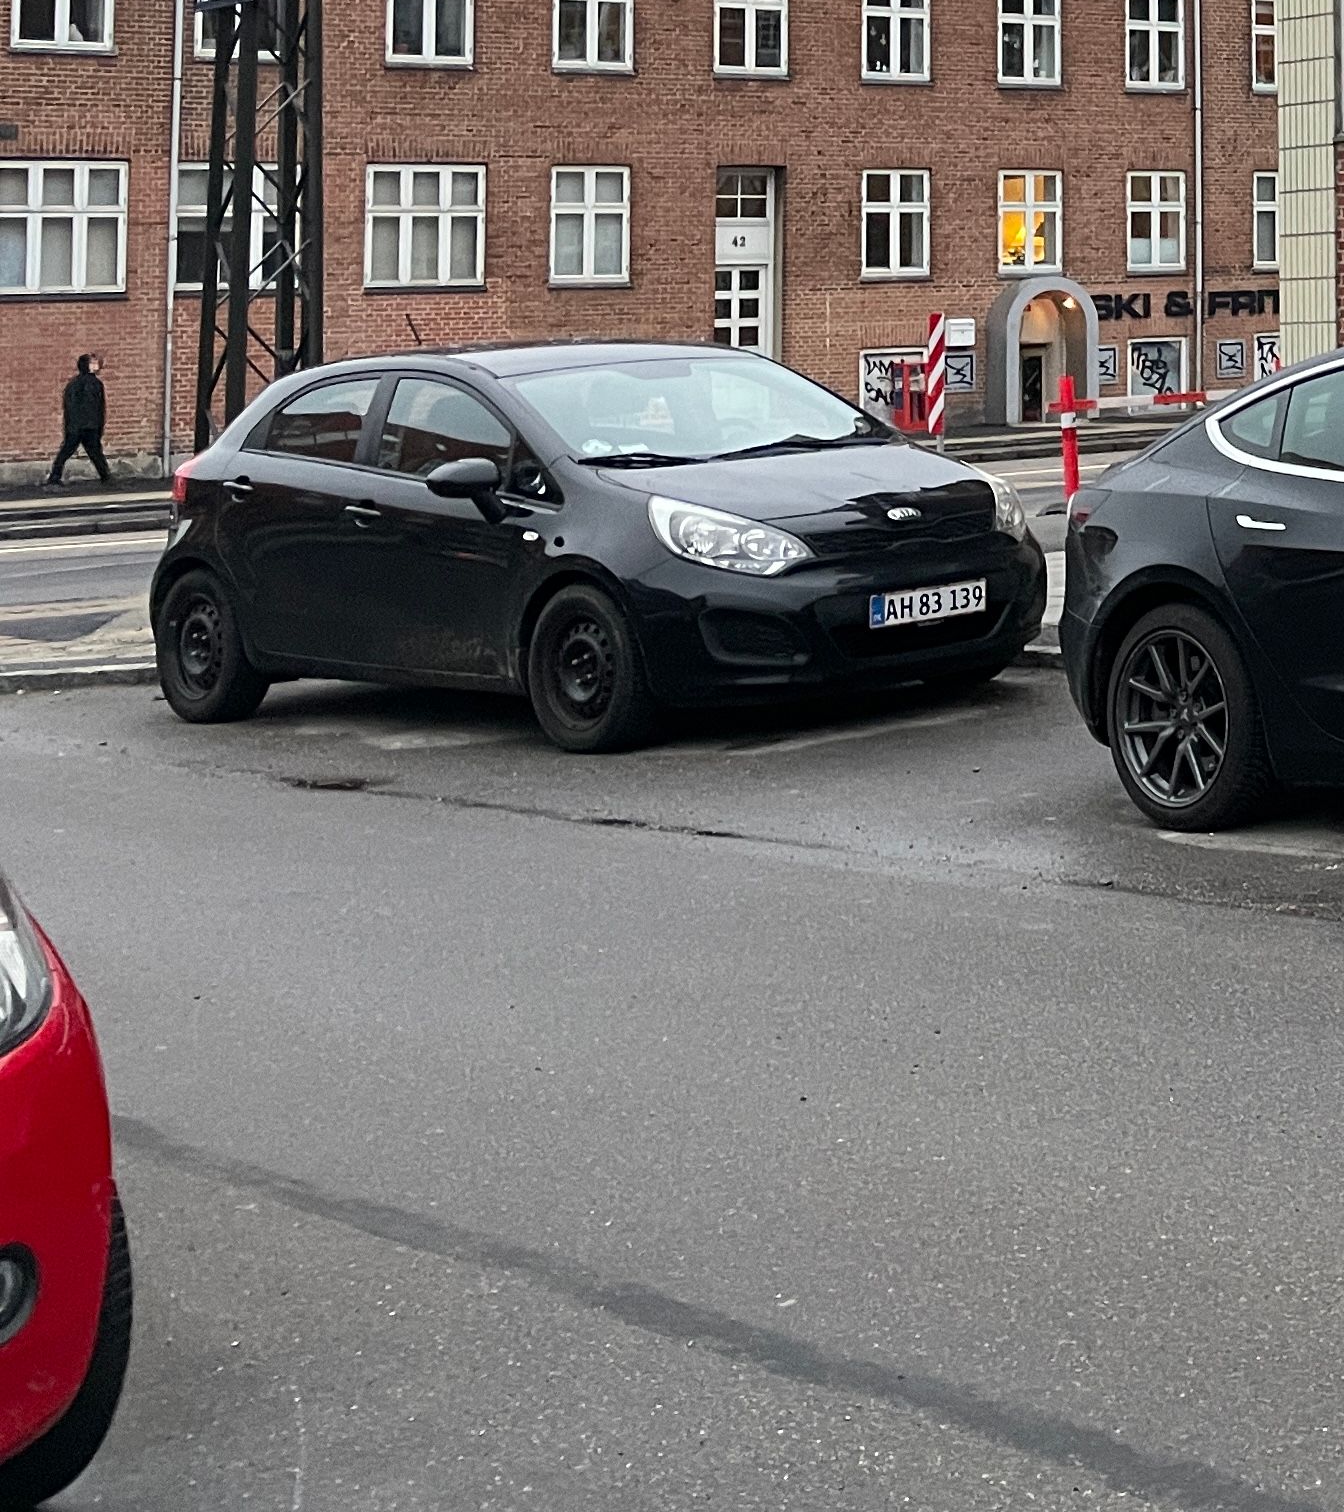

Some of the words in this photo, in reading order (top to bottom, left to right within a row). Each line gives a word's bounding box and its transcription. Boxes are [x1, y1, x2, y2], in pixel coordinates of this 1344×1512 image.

[731, 236, 746, 248] 42
[1164, 291, 1194, 317] &
[885, 596, 914, 621] AH
[919, 591, 943, 616] 83
[950, 586, 983, 611] 139
